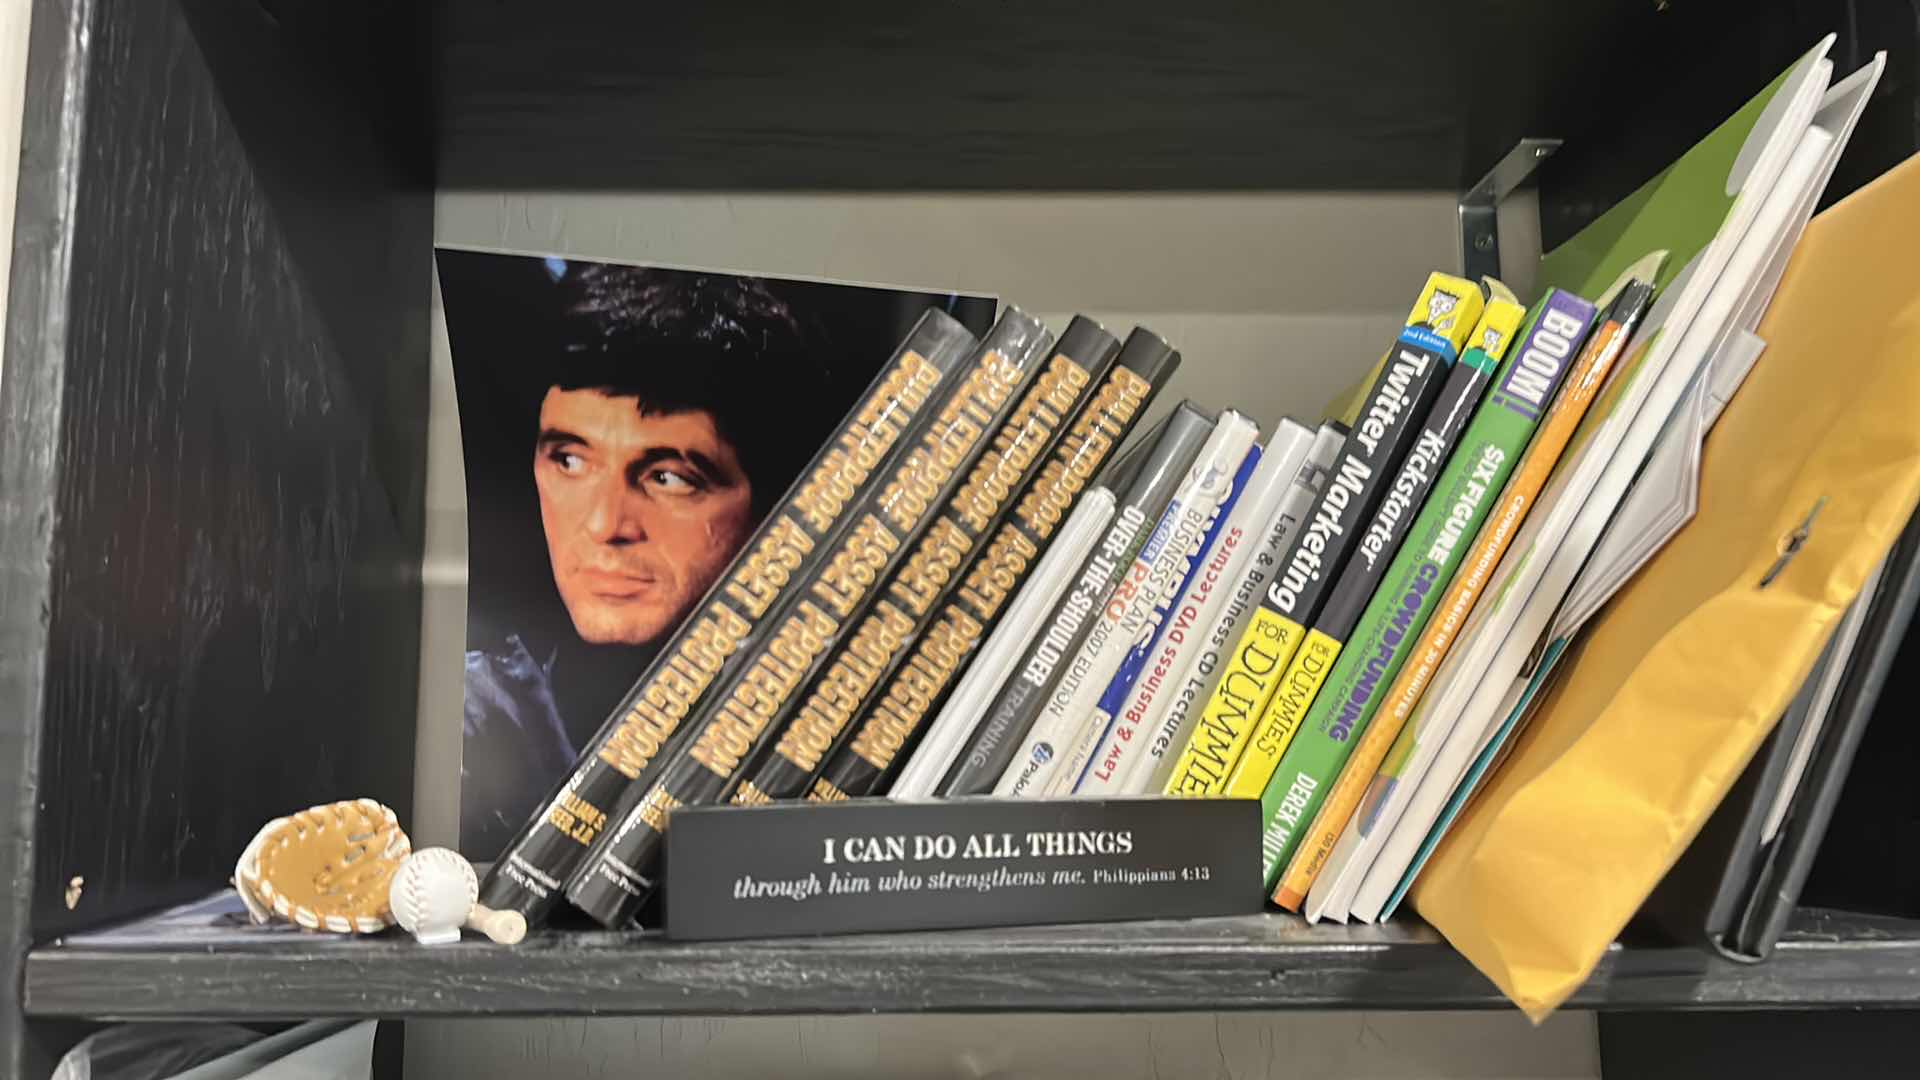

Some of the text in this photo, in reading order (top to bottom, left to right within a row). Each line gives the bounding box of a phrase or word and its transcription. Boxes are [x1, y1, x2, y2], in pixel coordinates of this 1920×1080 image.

[1008, 361, 1156, 540] BULLETPROOF
[1260, 342, 1433, 618] Twitter Marketing
[595, 346, 948, 783] BULLETPROOF ASSET PROTECTION
[685, 343, 1028, 782] BULLETPROOF ASSET PROTECTION
[769, 350, 1097, 775] BULLETPROOF ASSET PROTECTION
[1140, 500, 1183, 562] PREMIER
[1146, 506, 1204, 588] BUSINESS
[1188, 523, 1247, 605] Lectures
[1424, 478, 1488, 567] FIGURE
[1462, 491, 1529, 591] CROWDFUNDING
[953, 520, 1044, 621] ASSET
[1018, 502, 1148, 689] OVER-THE-SHOULDER
[1101, 559, 1150, 625] PRO
[1119, 585, 1159, 635] PLAN
[1439, 587, 1474, 634] BASICS
[1082, 618, 1115, 658] 2007
[1146, 510, 1297, 761] Law & Business CD Lectures
[1165, 602, 1201, 645] DVD
[1324, 558, 1442, 746] CROWDFUNDING
[1431, 630, 1449, 649] IN
[843, 601, 990, 773] PROTECTION
[967, 679, 1032, 770] TRAINING
[1047, 654, 1094, 718] EDITION
[1121, 643, 1181, 725] Business
[1168, 615, 1292, 797] FOR DUMMIE
[1250, 650, 1329, 759] DUMMIES
[1389, 661, 1432, 720] MINUTES
[1091, 742, 1126, 783] Law
[1113, 722, 1135, 743] &
[823, 831, 1133, 864] I CAN DO ALL THINGS
[1262, 769, 1319, 881] DEREK MILL
[734, 866, 1211, 900] through him who strengthens me. Philippians 4:13
